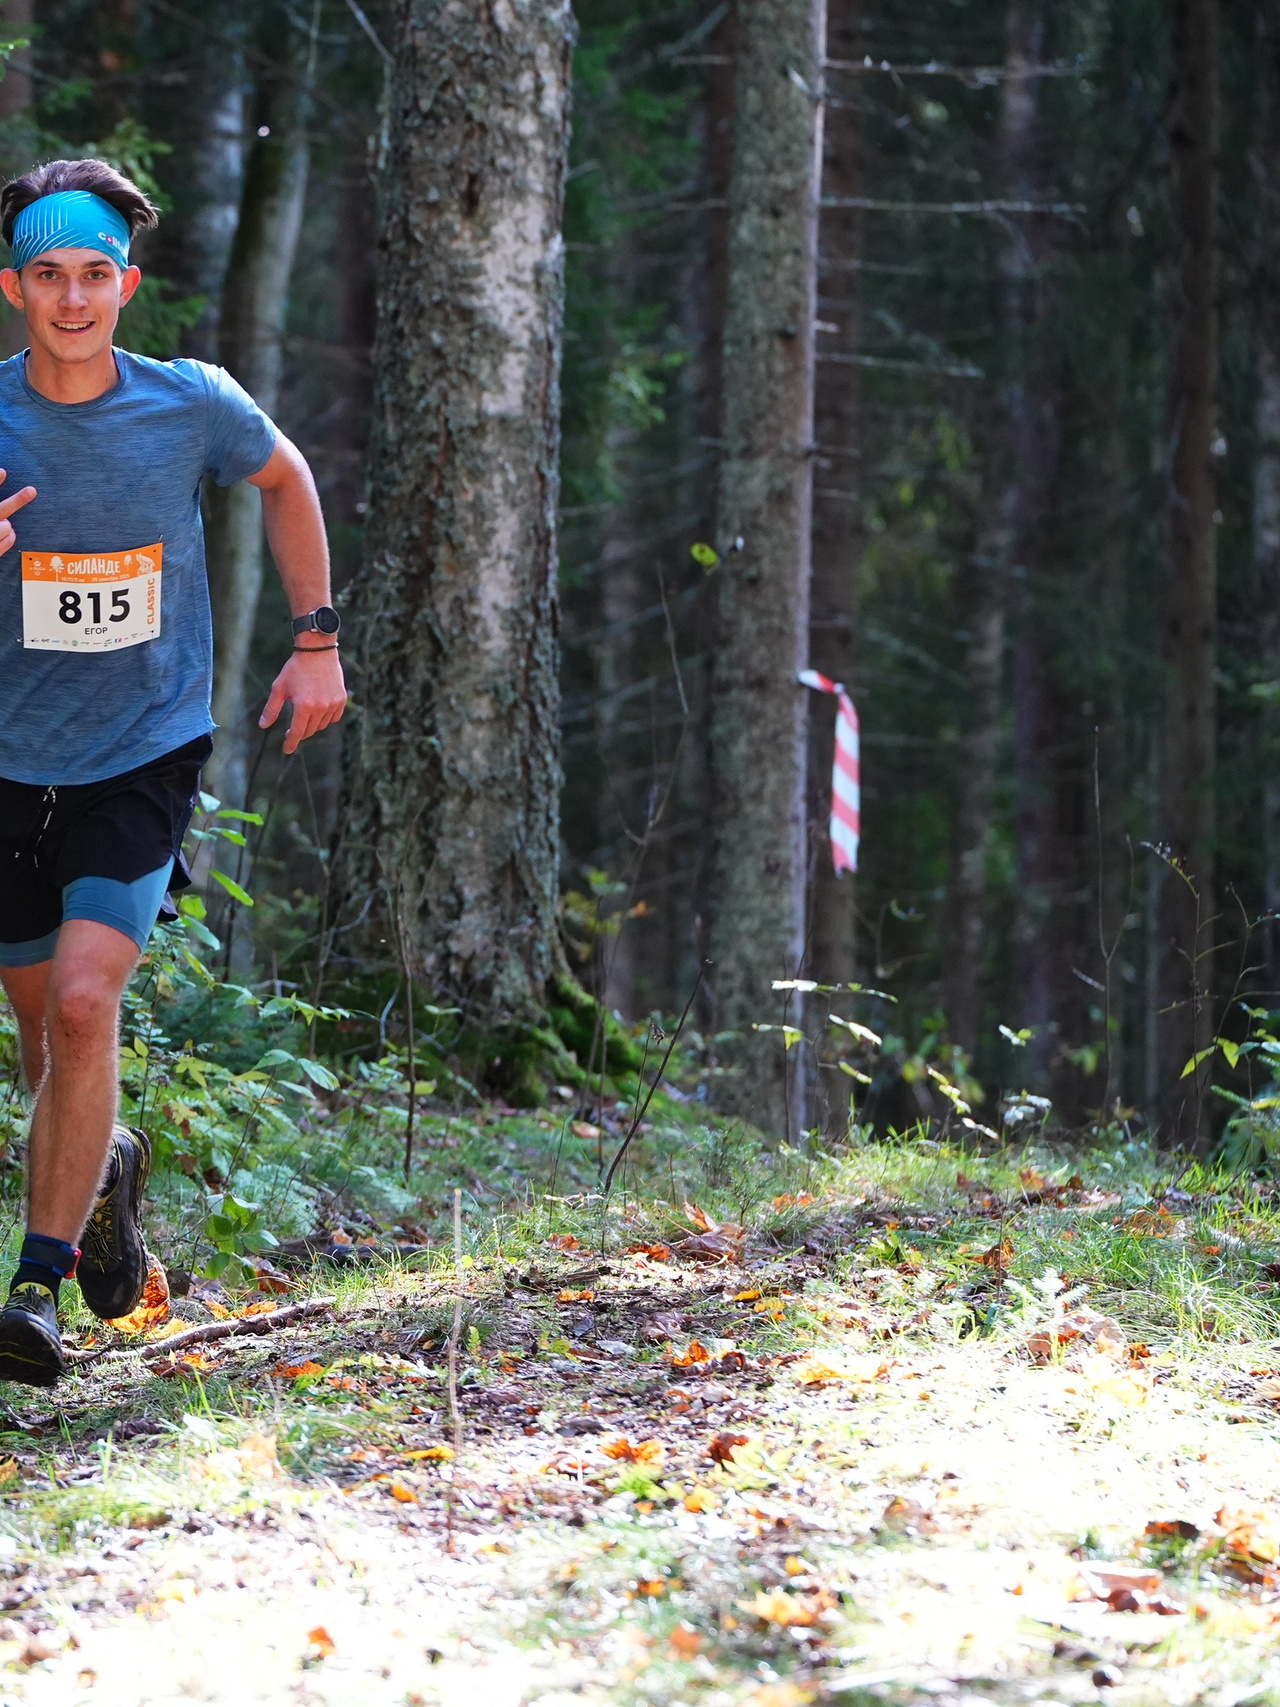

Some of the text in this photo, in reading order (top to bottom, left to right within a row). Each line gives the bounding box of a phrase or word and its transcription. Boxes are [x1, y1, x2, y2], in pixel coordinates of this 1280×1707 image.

[68, 558, 120, 575] СИЛАНДЕ
[59, 588, 130, 624] 815
[147, 578, 156, 625] CLASSIC
[84, 627, 108, 635] ЕГОР
